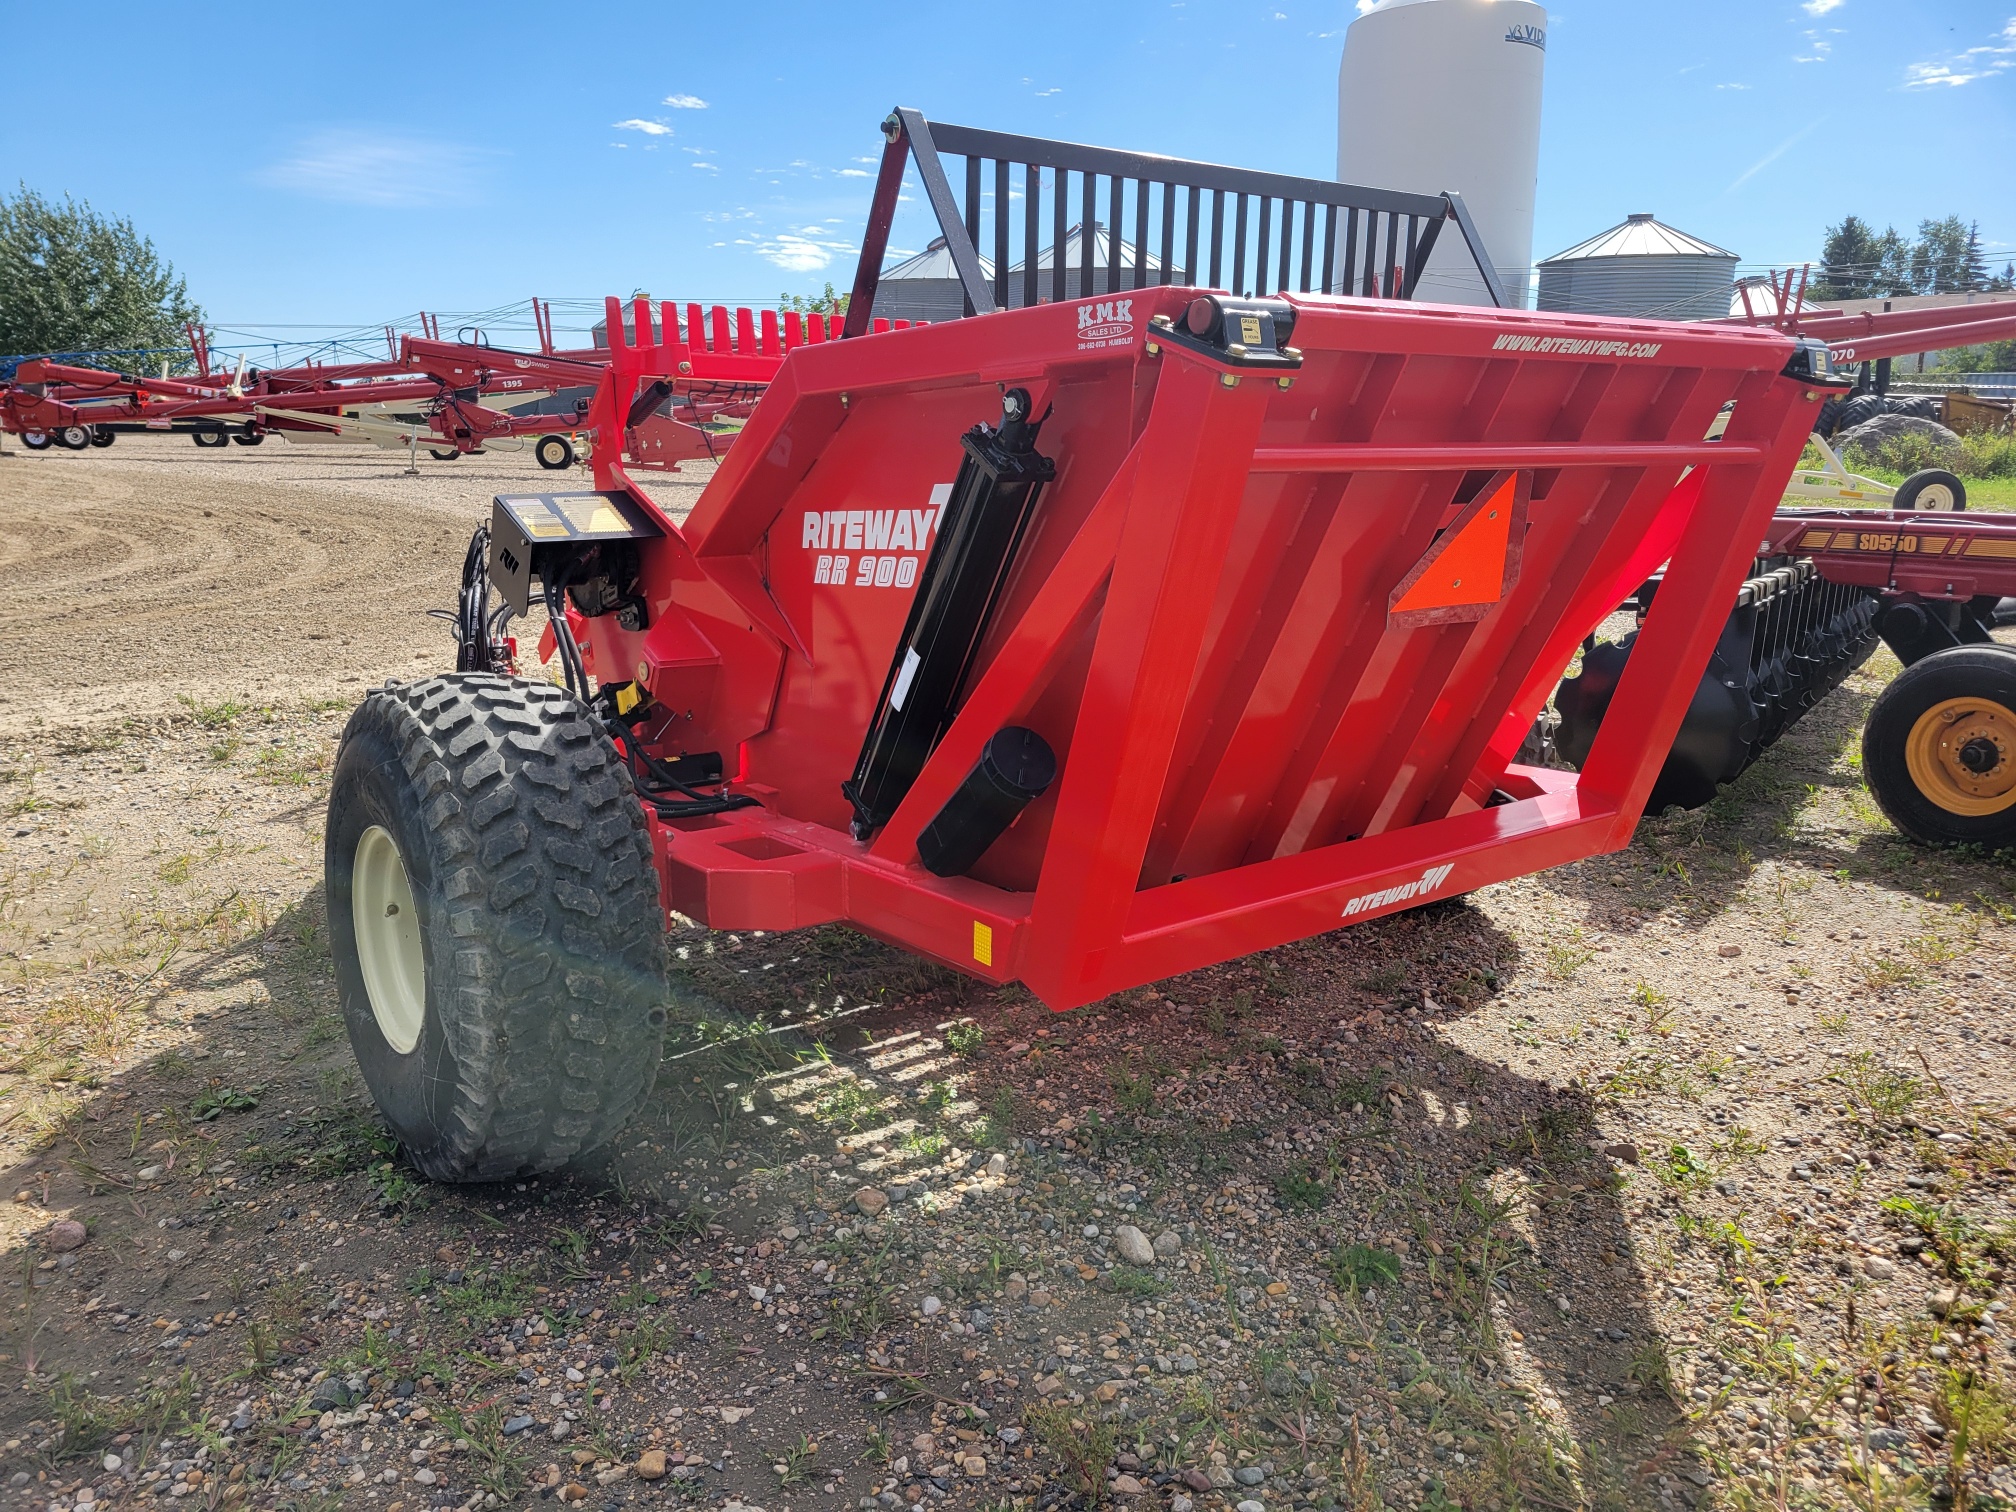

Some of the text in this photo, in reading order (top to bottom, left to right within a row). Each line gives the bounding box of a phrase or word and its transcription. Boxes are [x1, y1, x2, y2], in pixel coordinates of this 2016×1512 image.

[1087, 326, 1123, 337] SALES LTD.
[1108, 336, 1133, 347] HUMBOLDT
[1492, 334, 1662, 358] WWW.RITEWAYMFG.COM
[531, 361, 550, 369] SWING
[502, 380, 522, 388] 1395
[802, 509, 936, 551] RITEWAY
[814, 555, 918, 588] RR 900
[1341, 880, 1422, 917] RITEWAY
